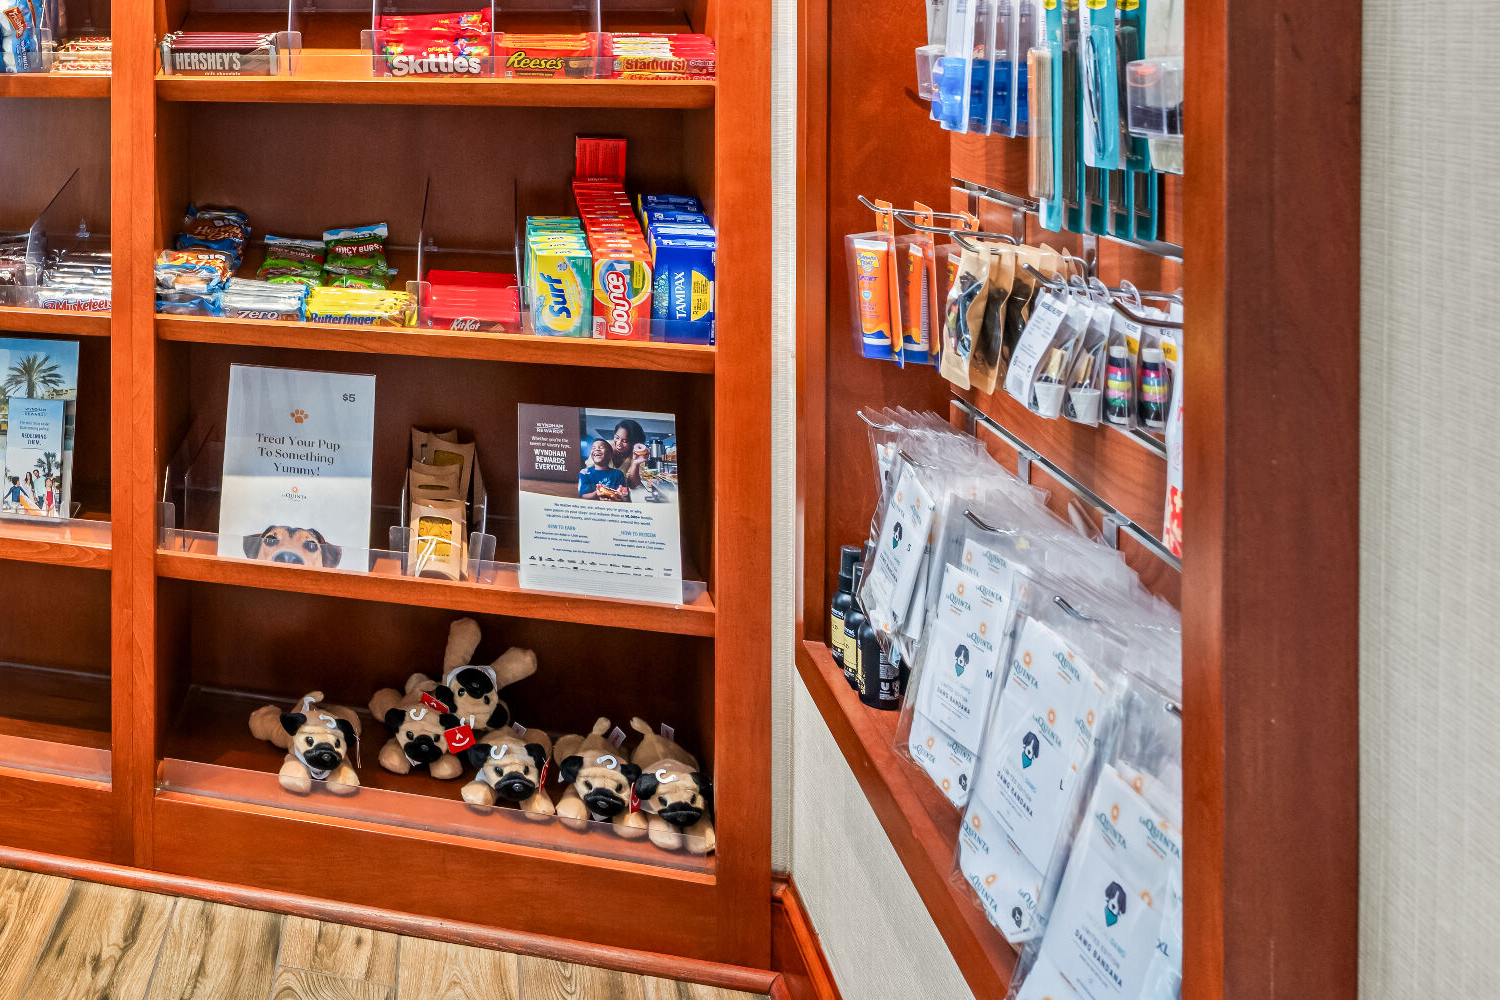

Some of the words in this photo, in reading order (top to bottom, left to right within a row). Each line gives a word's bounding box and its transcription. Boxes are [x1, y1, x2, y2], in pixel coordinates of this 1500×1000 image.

[175, 52, 241, 71] HERSHEY'S
[392, 52, 481, 76] Skittles
[625, 58, 686, 71] Starburst
[539, 271, 572, 319] Surf
[674, 272, 685, 319] TAMPAX
[607, 271, 632, 335] bounce
[237, 310, 278, 320] Zero
[311, 313, 377, 325] Butterfinger
[342, 393, 356, 403] $5
[256, 433, 285, 444] Treat
[287, 436, 315, 448] Your
[318, 439, 341, 452] Pup
[258, 446, 273, 458] To
[274, 449, 335, 465] Something
[534, 449, 567, 457] WYNDHAM
[536, 456, 565, 464] REWARDS
[273, 462, 320, 477] Yummy!
[535, 463, 568, 471] EVERYONE.
[985, 670, 993, 680] M
[1156, 939, 1169, 957] XL
